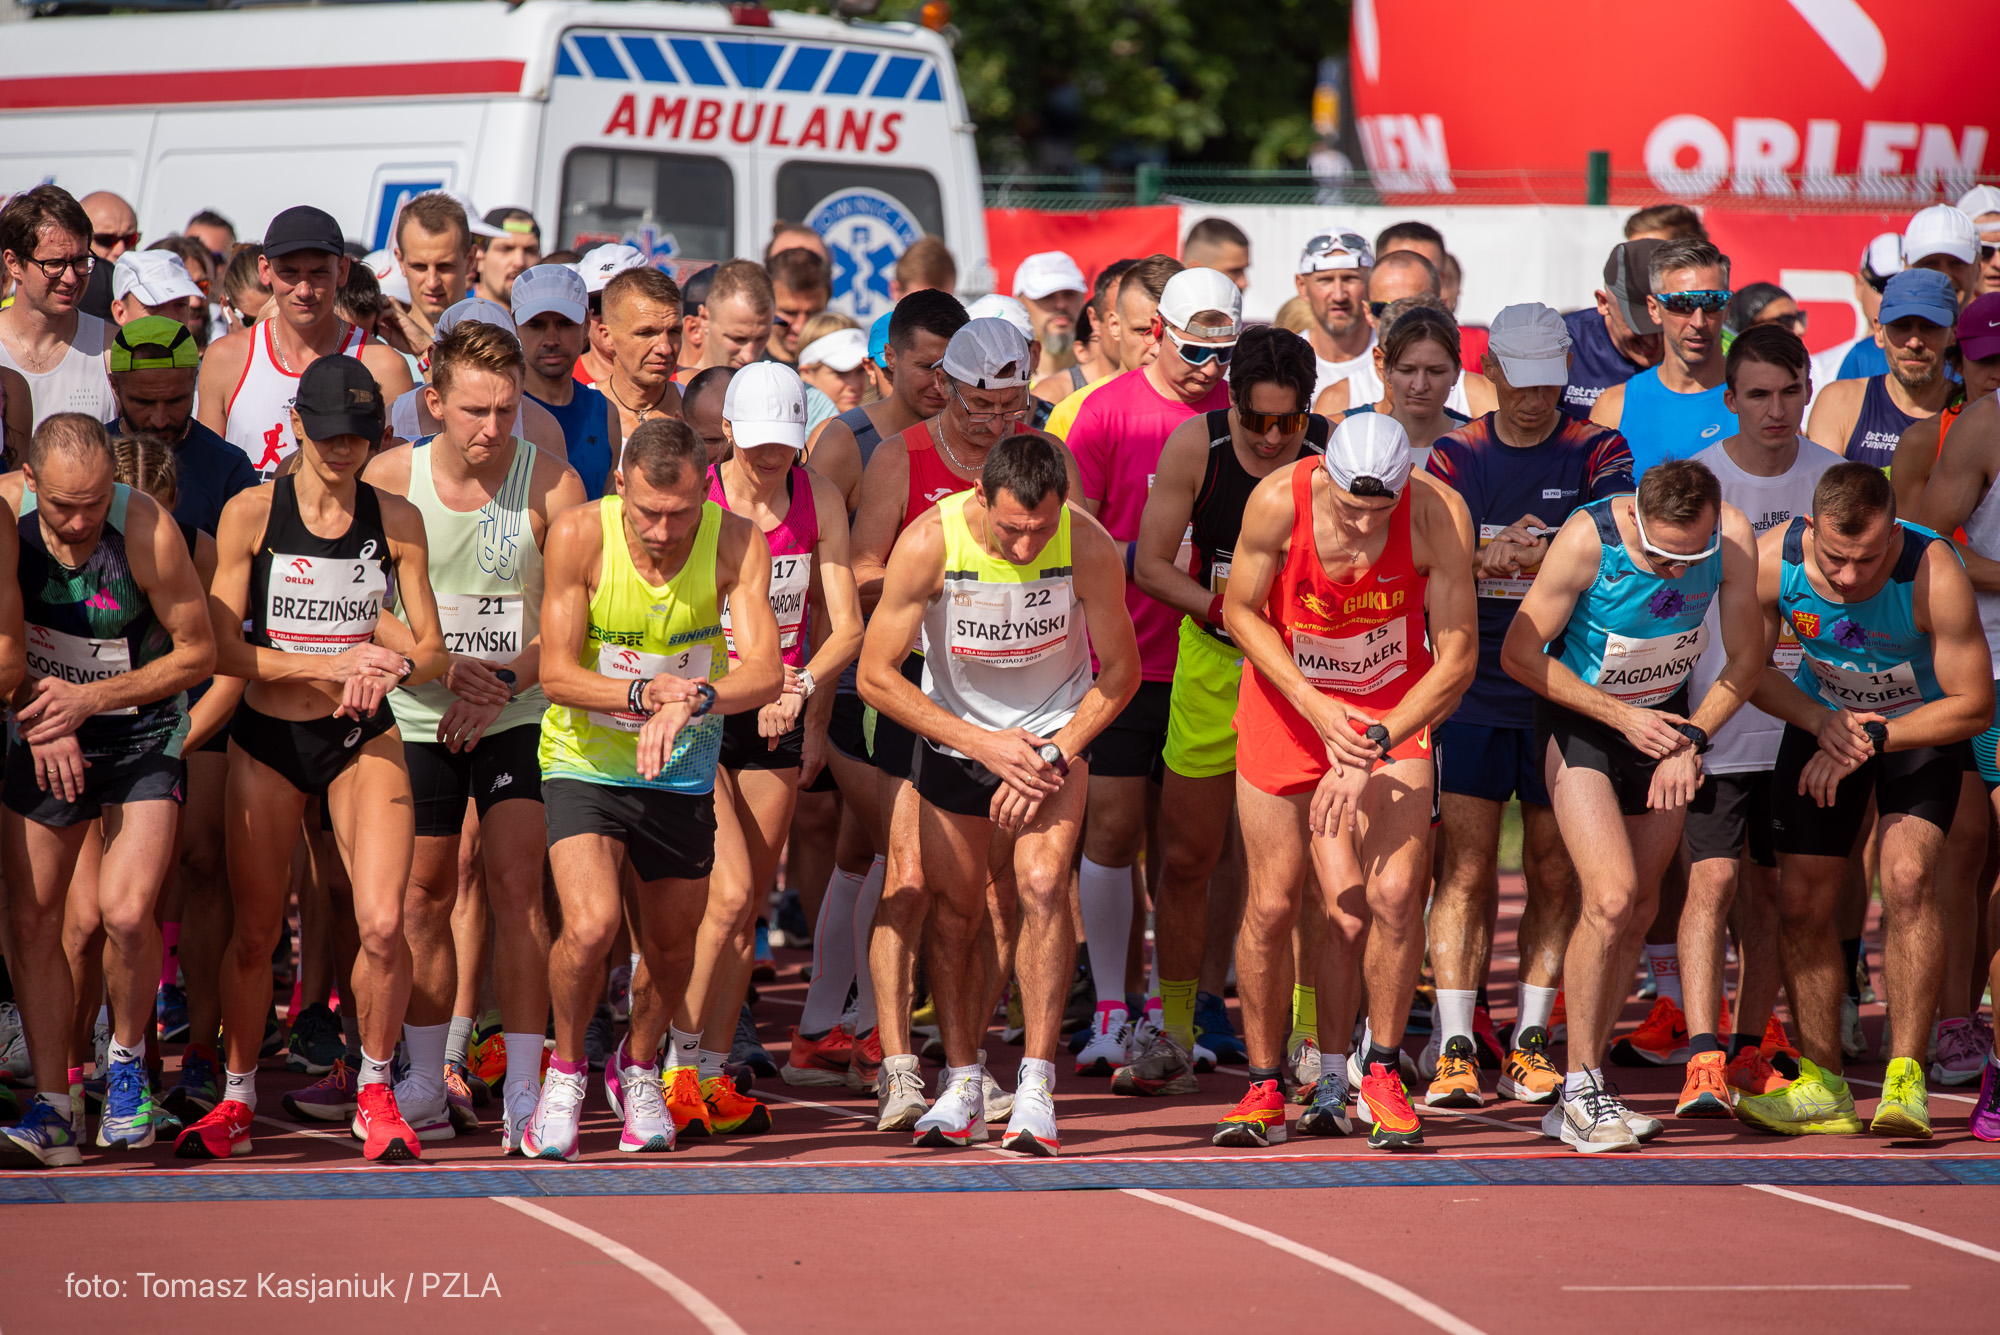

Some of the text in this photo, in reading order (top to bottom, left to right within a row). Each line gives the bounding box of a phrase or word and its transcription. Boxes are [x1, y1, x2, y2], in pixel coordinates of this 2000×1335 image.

[602, 94, 905, 153] AMBULANS
[1643, 113, 1989, 200] ORLEN
[1771, 511, 1790, 520] BIEG
[352, 564, 366, 583] 2
[774, 560, 797, 579] 17
[285, 576, 314, 585] ORLEN
[1024, 589, 1052, 609] 22
[1343, 590, 1405, 615] GUKLA
[1685, 591, 1709, 602] EKIPA
[272, 595, 378, 622] BRZEZIŃSKA
[477, 597, 505, 616] 21
[277, 632, 290, 640] PZLA
[957, 614, 1066, 641] STARŻYŃSKI
[1365, 625, 1389, 646] 15
[1795, 621, 1815, 637] CK
[1866, 630, 1891, 641] EKIPA
[30, 637, 55, 650] ORLEN
[88, 642, 102, 658] 7
[293, 645, 336, 654] GRUDZIĄDZ
[1674, 630, 1699, 651] 24
[678, 653, 689, 669] 3
[1298, 641, 1403, 675] MARSZAŁEK
[26, 651, 128, 685] GOSIEWS
[612, 663, 641, 675] ORLEN
[1868, 673, 1897, 686] 11
